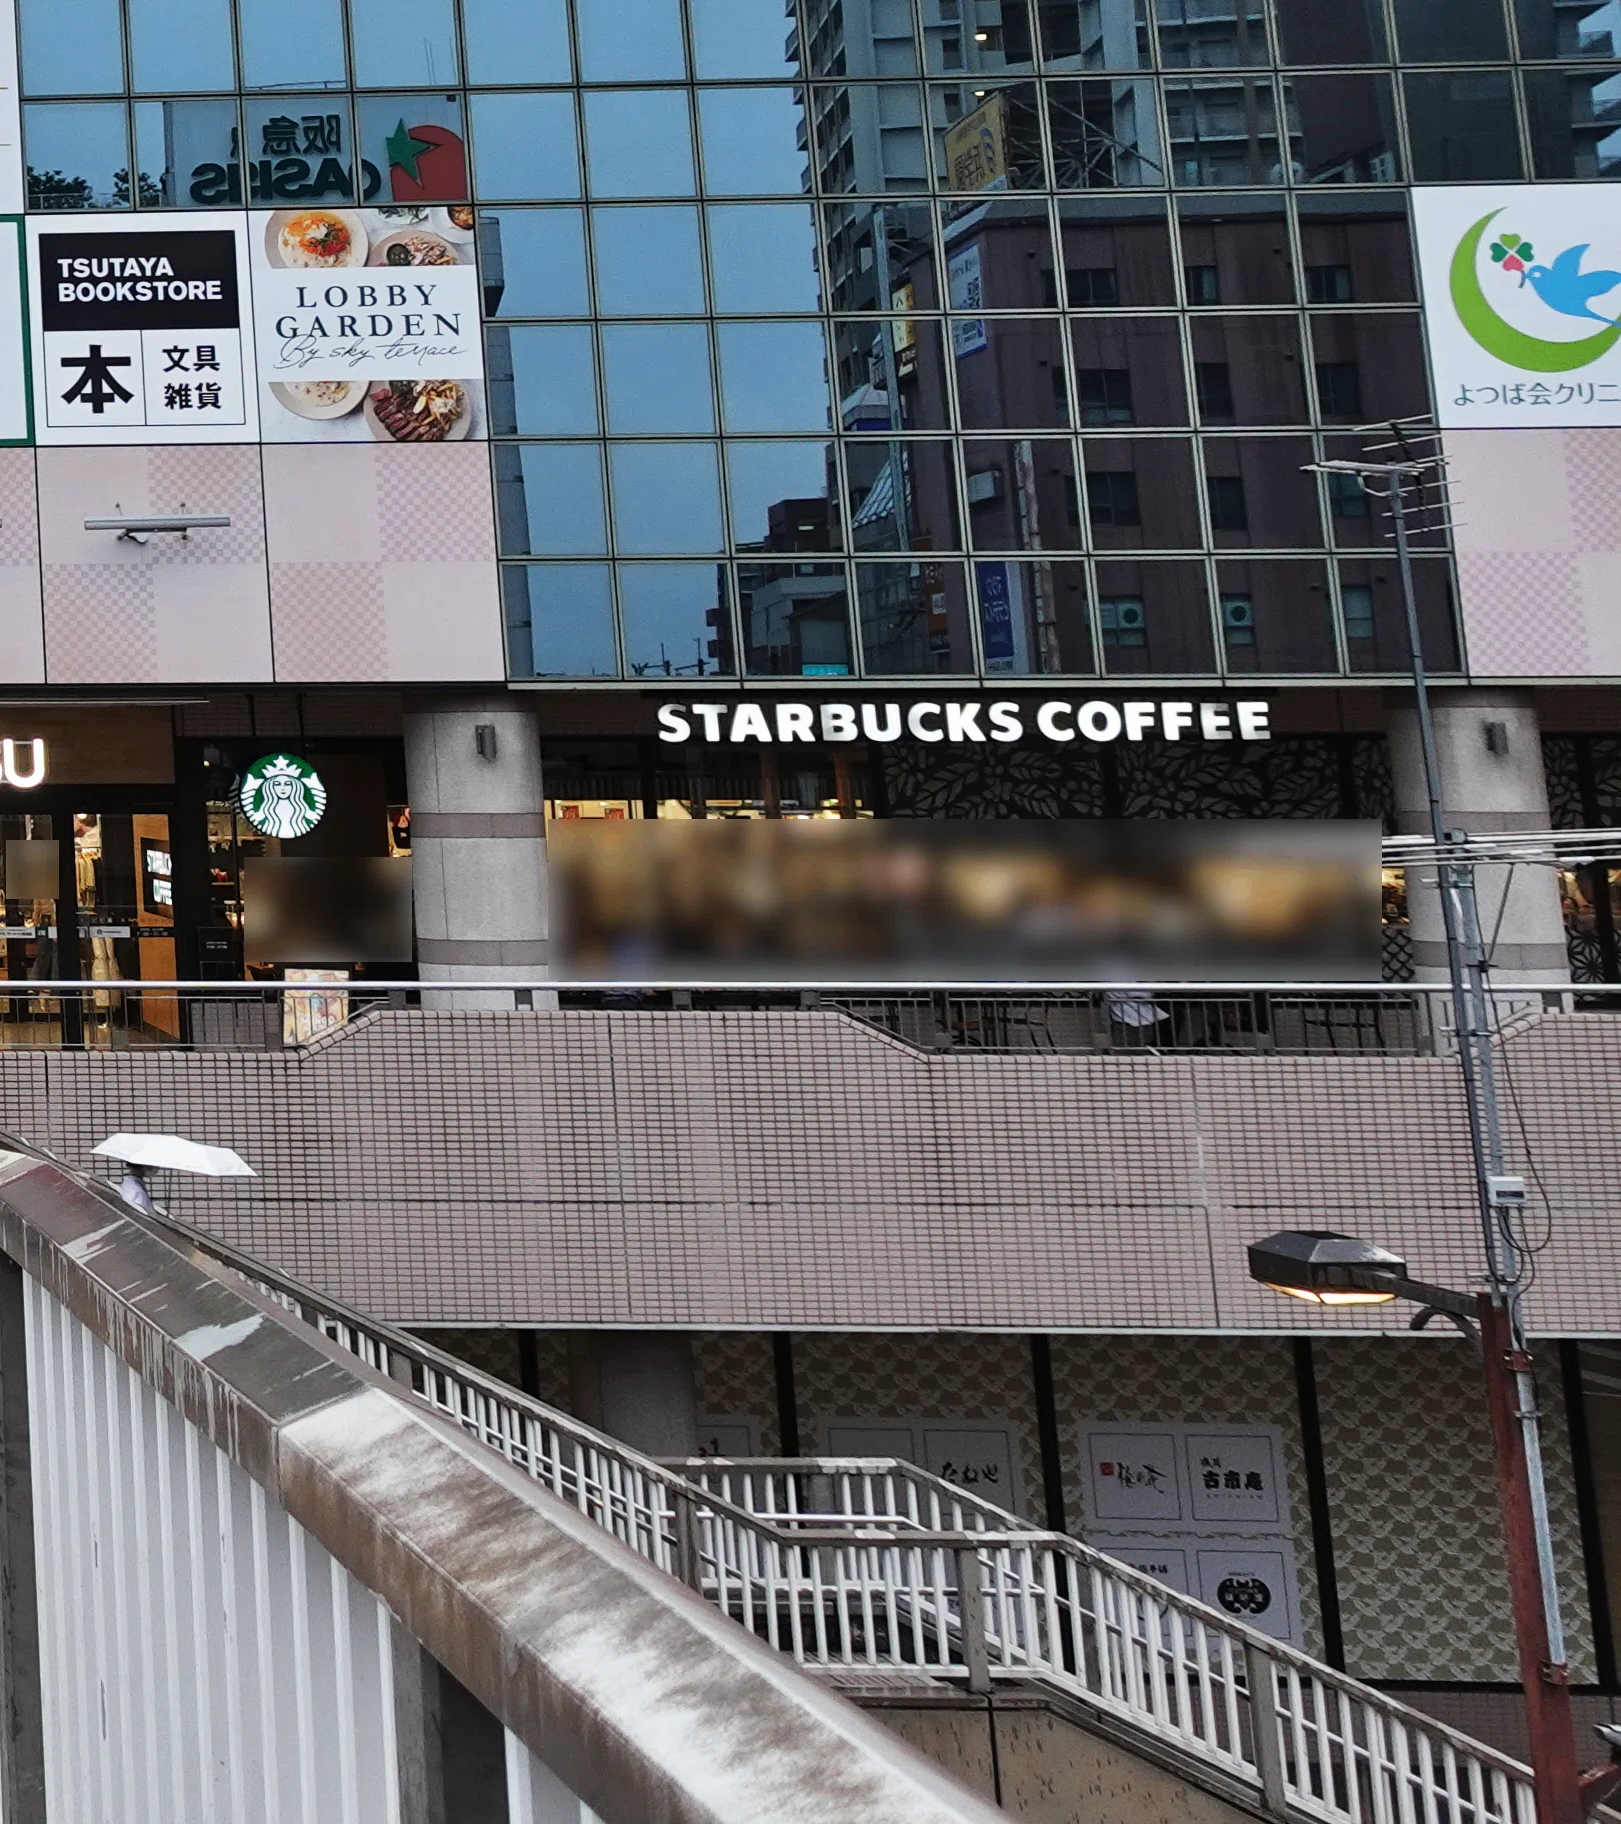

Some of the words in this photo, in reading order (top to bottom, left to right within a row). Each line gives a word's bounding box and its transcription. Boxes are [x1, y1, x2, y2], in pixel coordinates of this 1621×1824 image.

[57, 256, 174, 279] TSUTAYA
[57, 280, 223, 303] BOOKSTORE
[295, 283, 438, 309] LOBBY
[275, 313, 461, 339] GARDEN
[161, 344, 221, 373] 文具
[60, 343, 135, 414] 本
[163, 381, 222, 411] 雑貨
[1453, 382, 1621, 406] よつば会クリニ
[657, 702, 1024, 744] STARBUCKS
[1036, 700, 1272, 743] COFFEE
